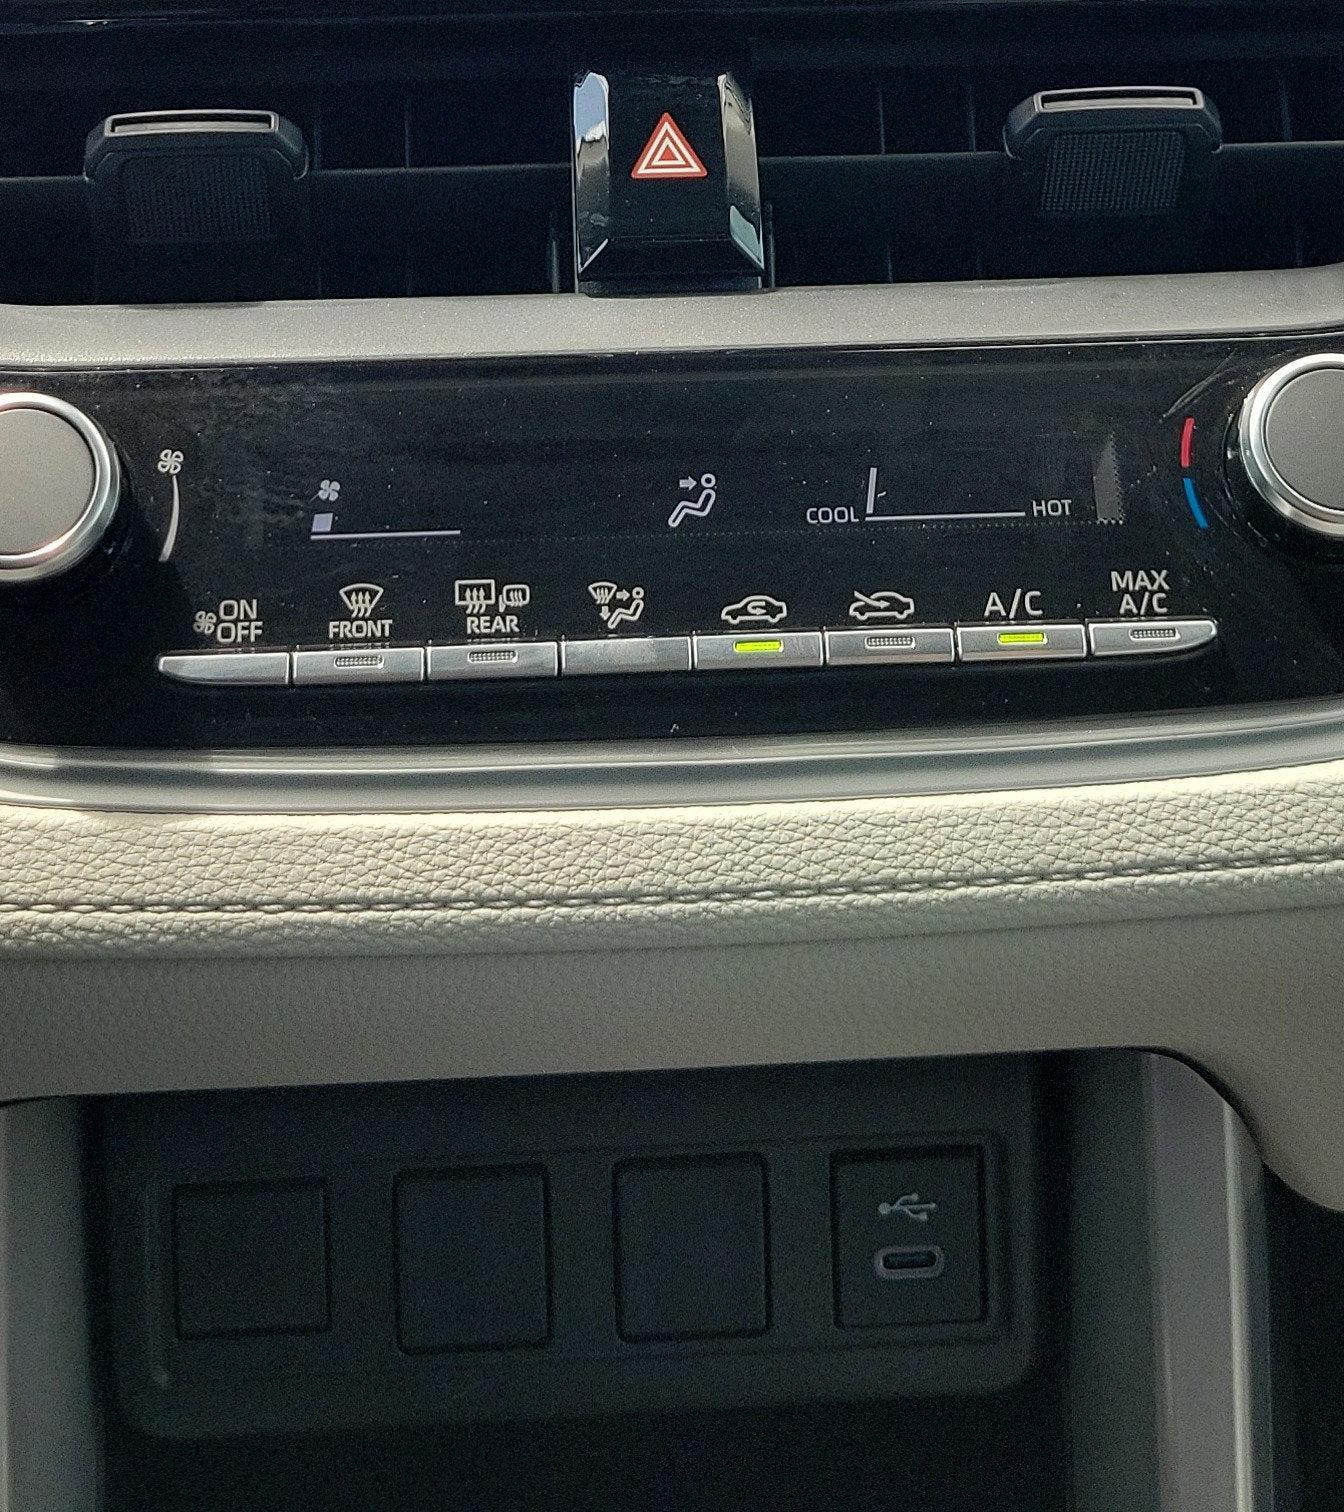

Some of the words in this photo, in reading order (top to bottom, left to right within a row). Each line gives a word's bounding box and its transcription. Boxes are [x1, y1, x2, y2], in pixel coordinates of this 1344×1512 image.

[806, 506, 859, 525] COOL
[1032, 498, 1073, 518] HOT
[1110, 569, 1170, 592] MAX
[218, 599, 257, 620] ON
[983, 589, 1043, 619] A/C
[1119, 592, 1168, 615] A/C
[216, 620, 263, 643] OFF
[328, 618, 394, 639] FRONT
[466, 614, 520, 634] REAR
